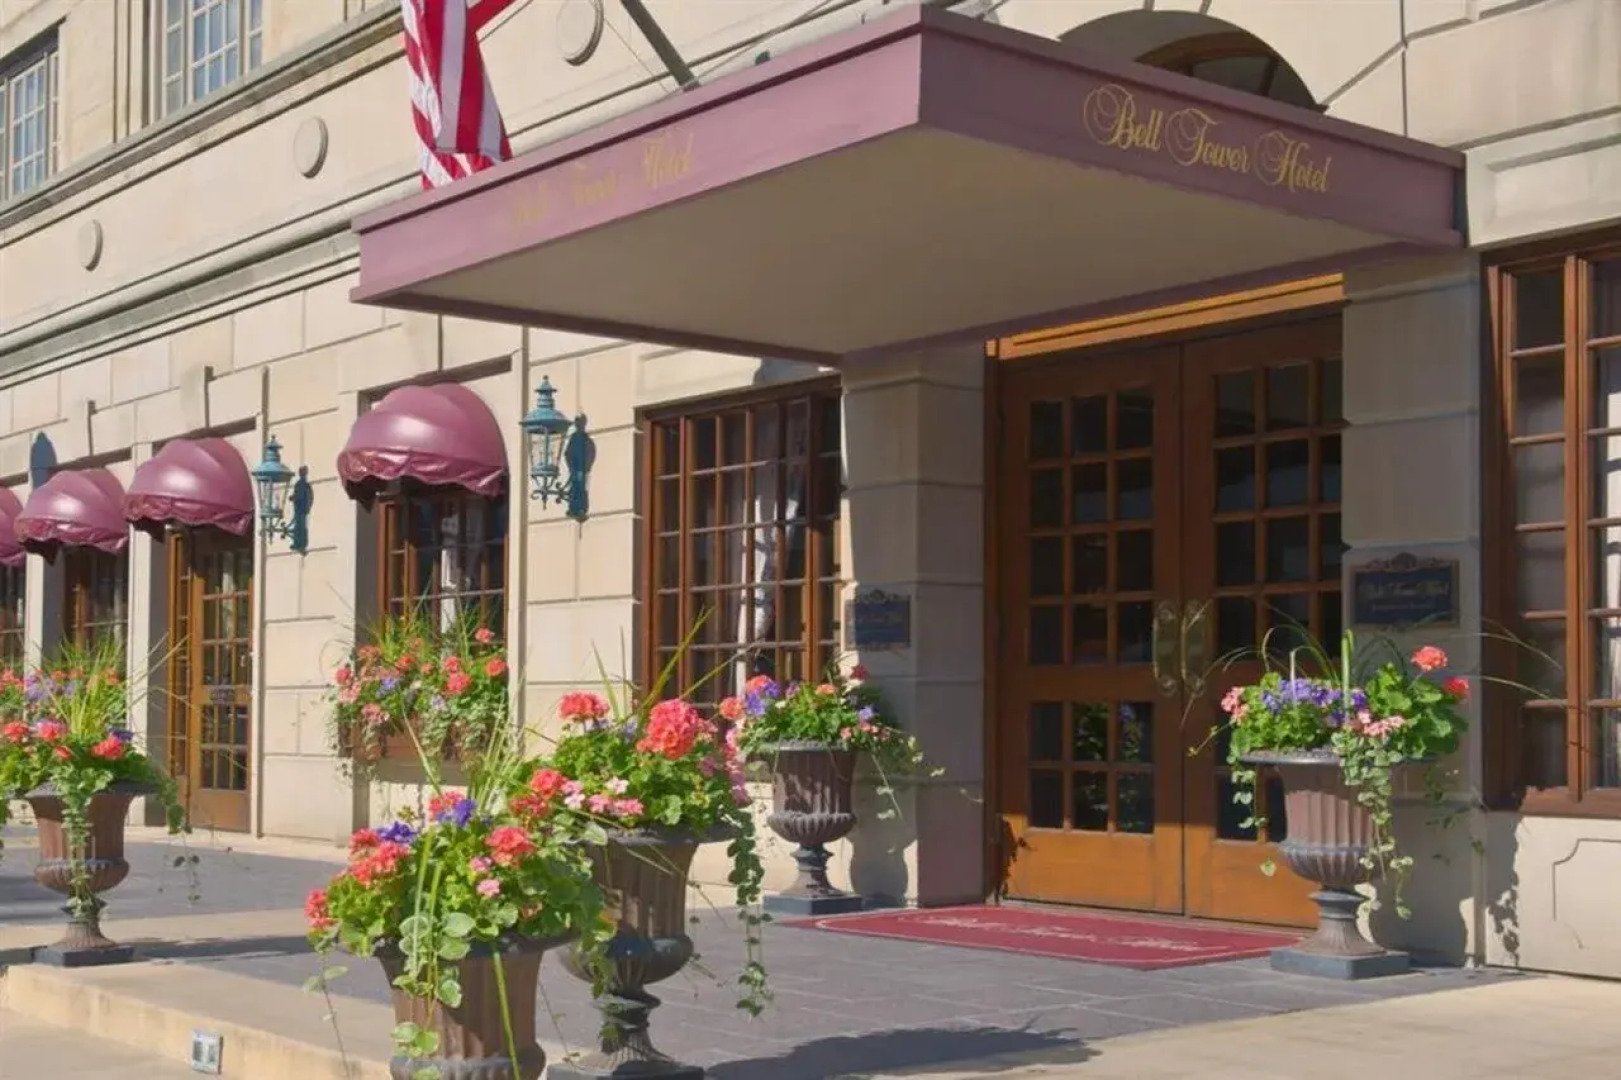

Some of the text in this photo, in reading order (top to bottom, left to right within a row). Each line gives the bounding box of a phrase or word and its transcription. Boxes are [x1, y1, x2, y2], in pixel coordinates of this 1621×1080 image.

[1083, 83, 1333, 193] Bell Tower Hotel
